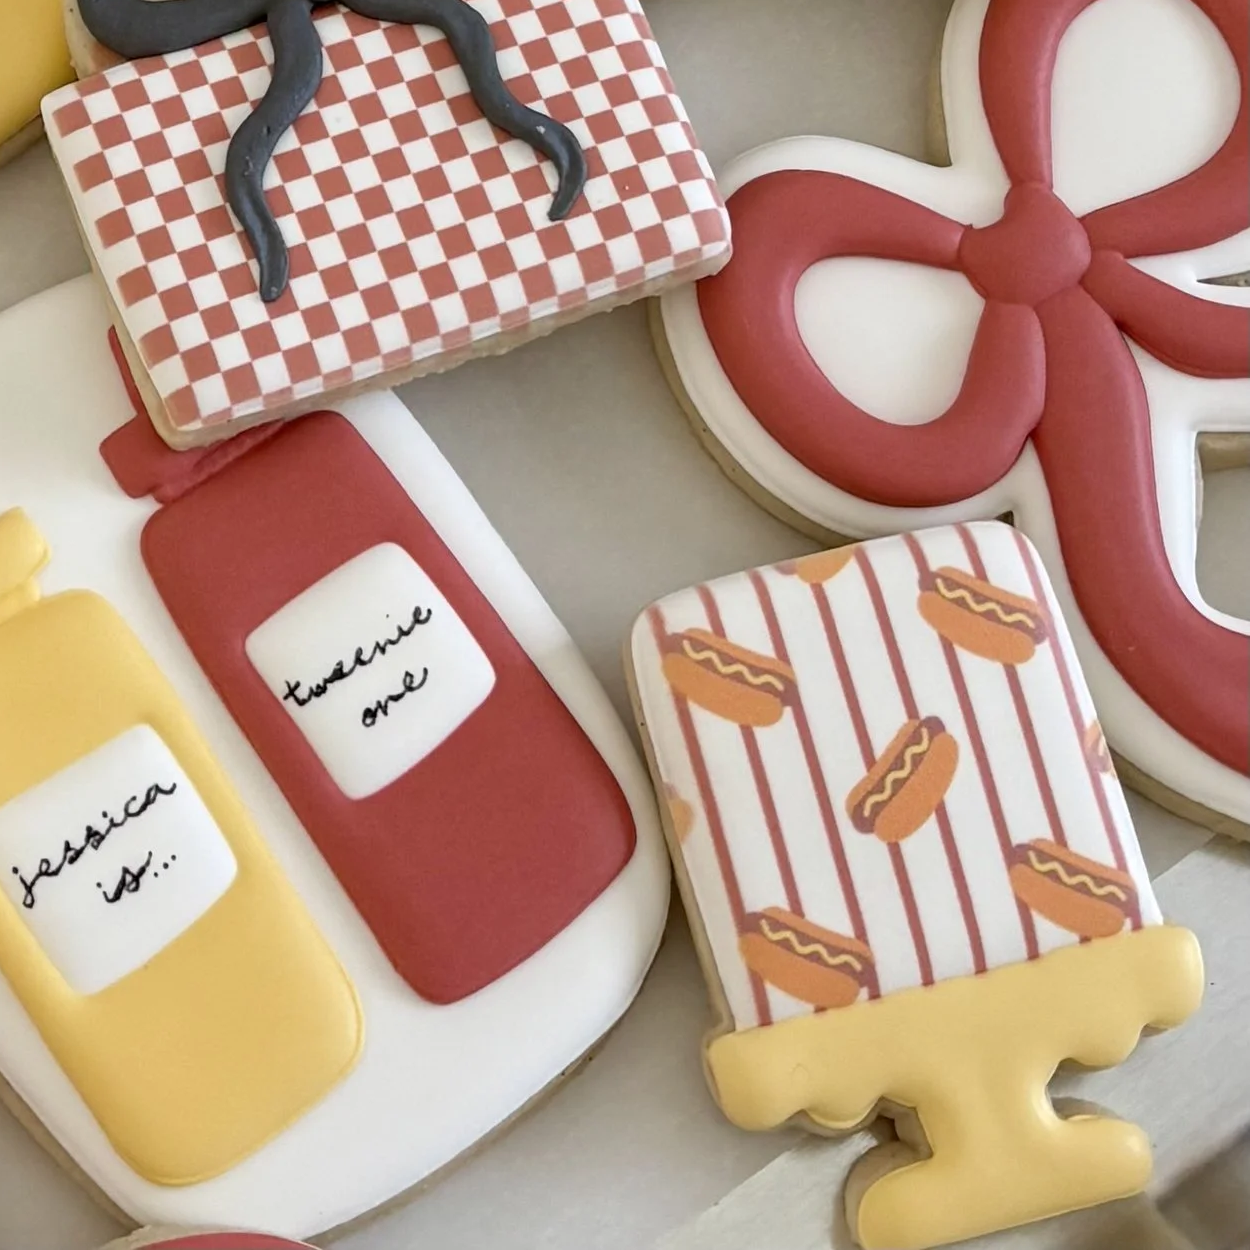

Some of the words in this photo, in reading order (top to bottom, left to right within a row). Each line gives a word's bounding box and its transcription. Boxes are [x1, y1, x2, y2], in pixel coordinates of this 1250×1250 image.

[282, 604, 433, 708] tweenie
[361, 666, 429, 728] one
[11, 781, 177, 909] jessica
